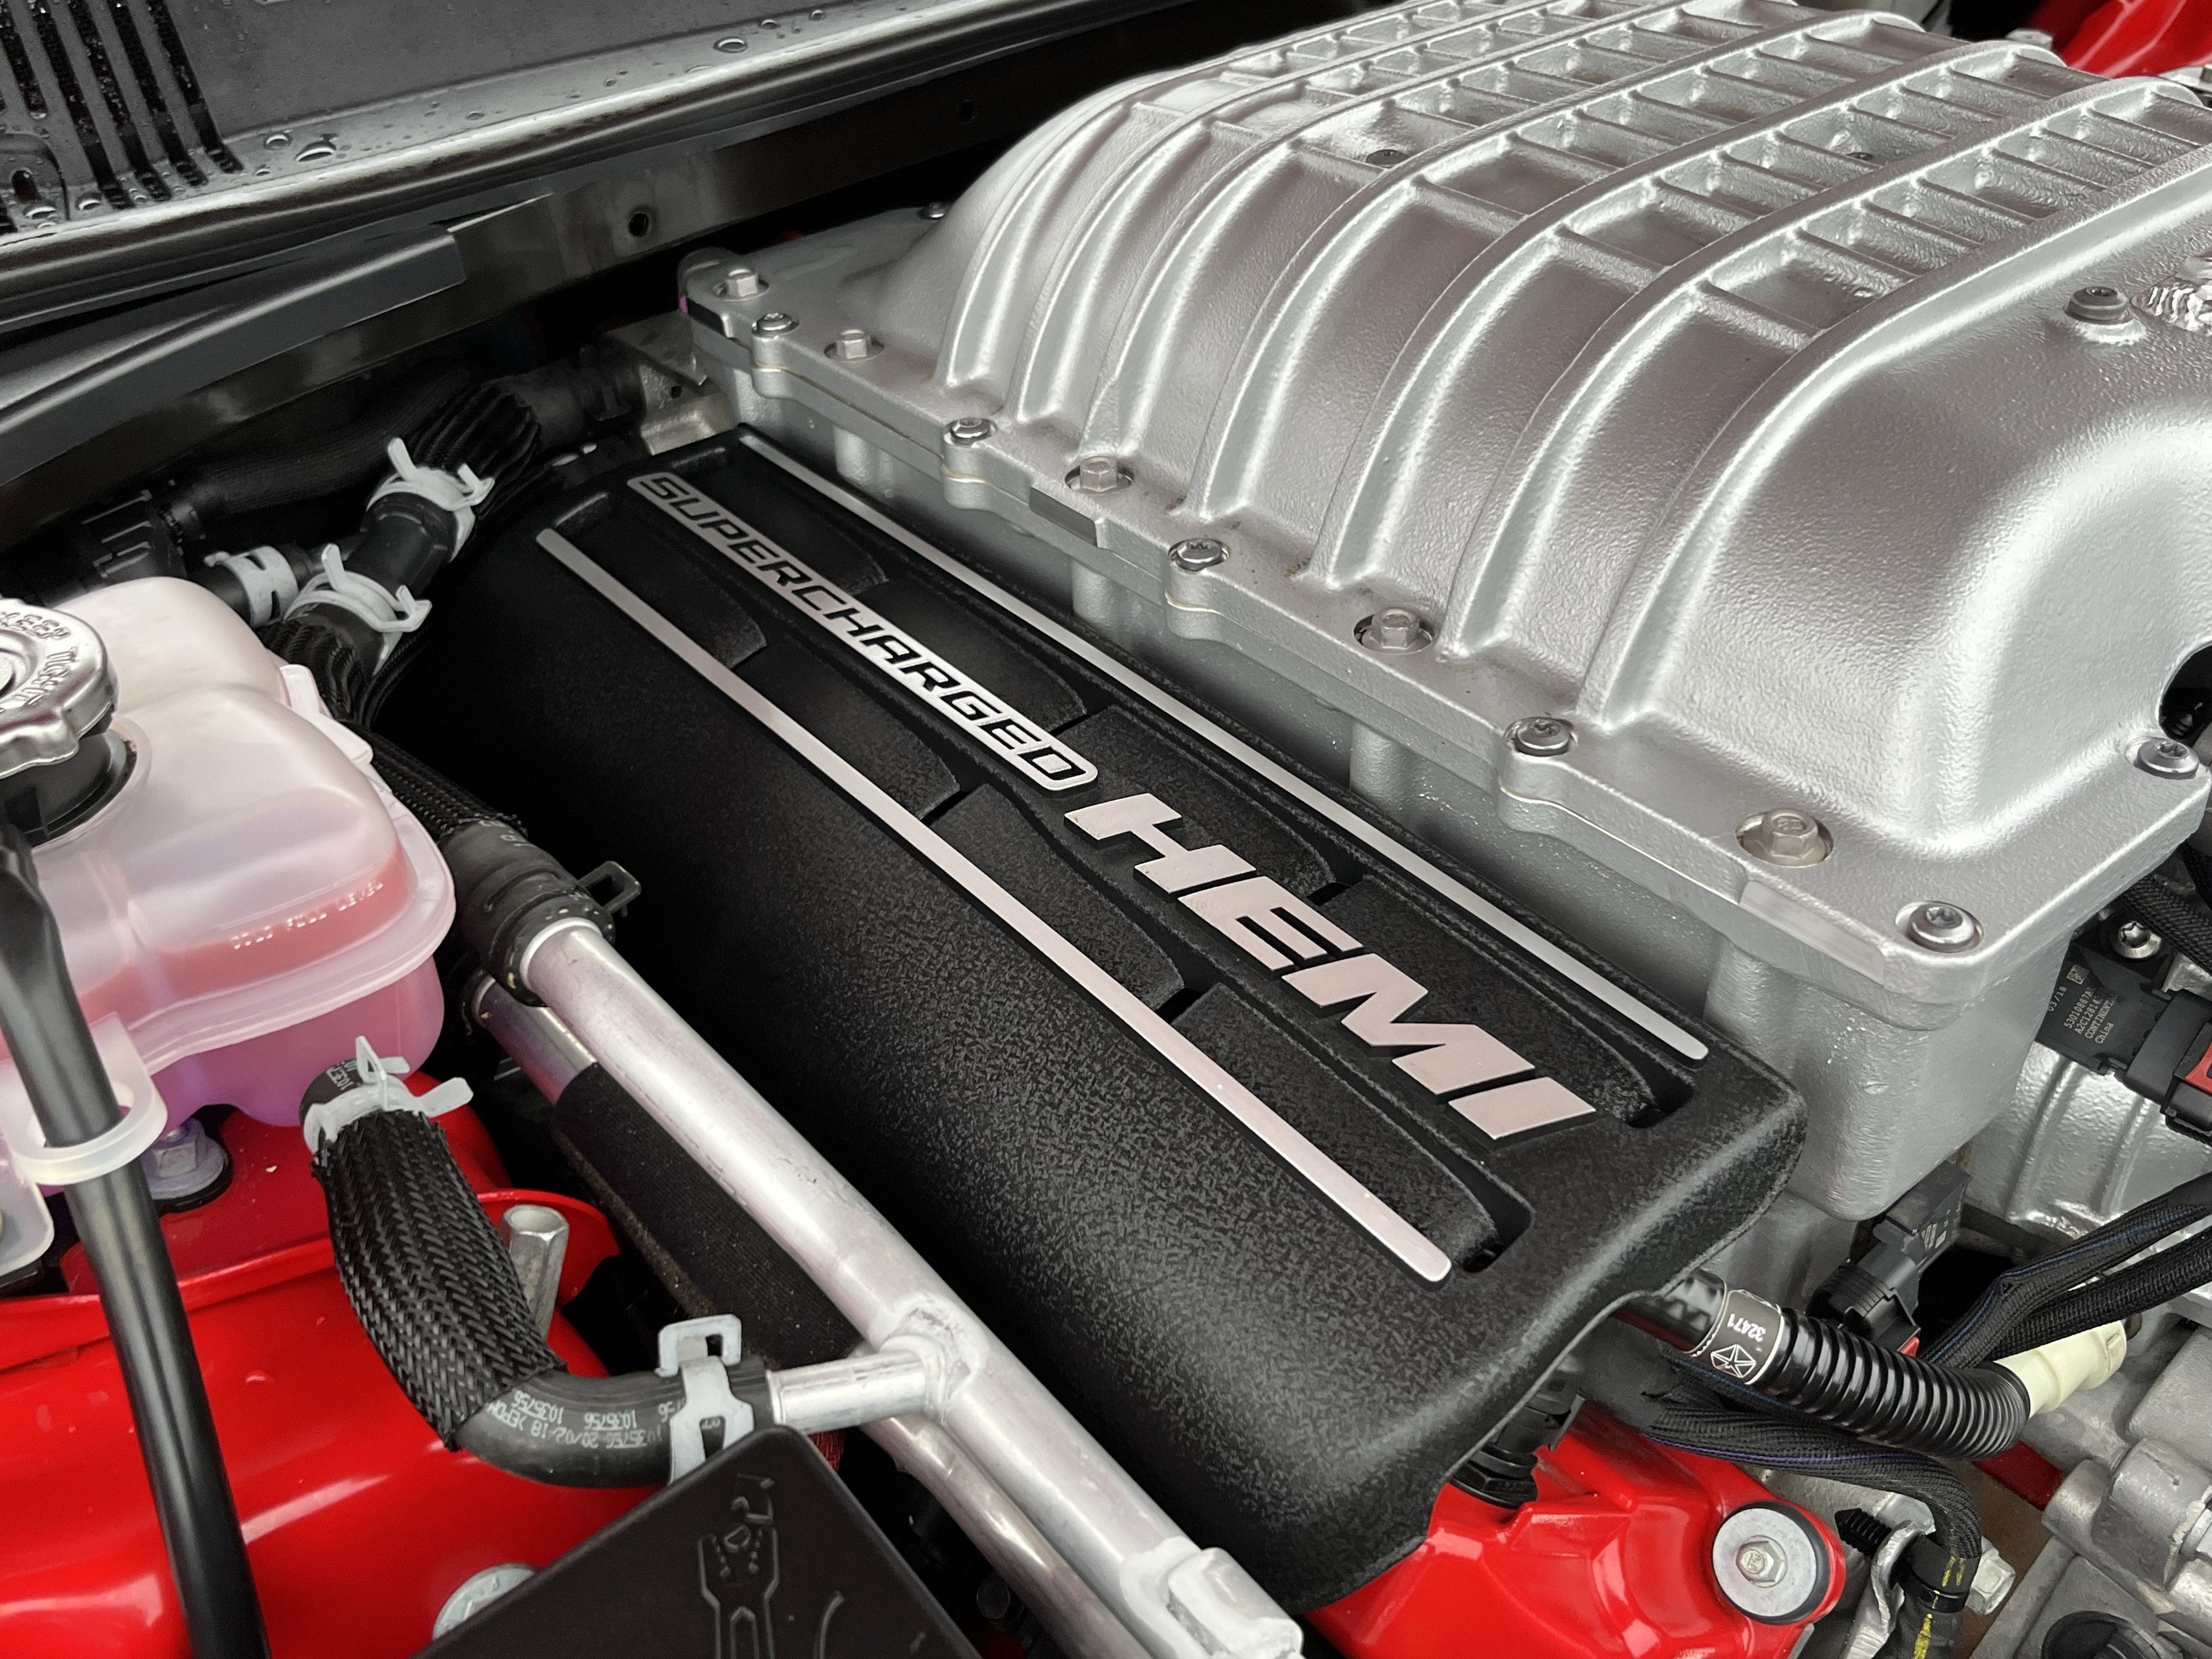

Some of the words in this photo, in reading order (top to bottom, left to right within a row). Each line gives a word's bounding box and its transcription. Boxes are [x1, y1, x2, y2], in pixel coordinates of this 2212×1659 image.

[637, 476, 1088, 780] SUPERCHARGED
[1064, 793, 1595, 1139] HEMI
[2095, 1022, 2114, 1044] China
[1726, 1313, 1767, 1342] 32471
